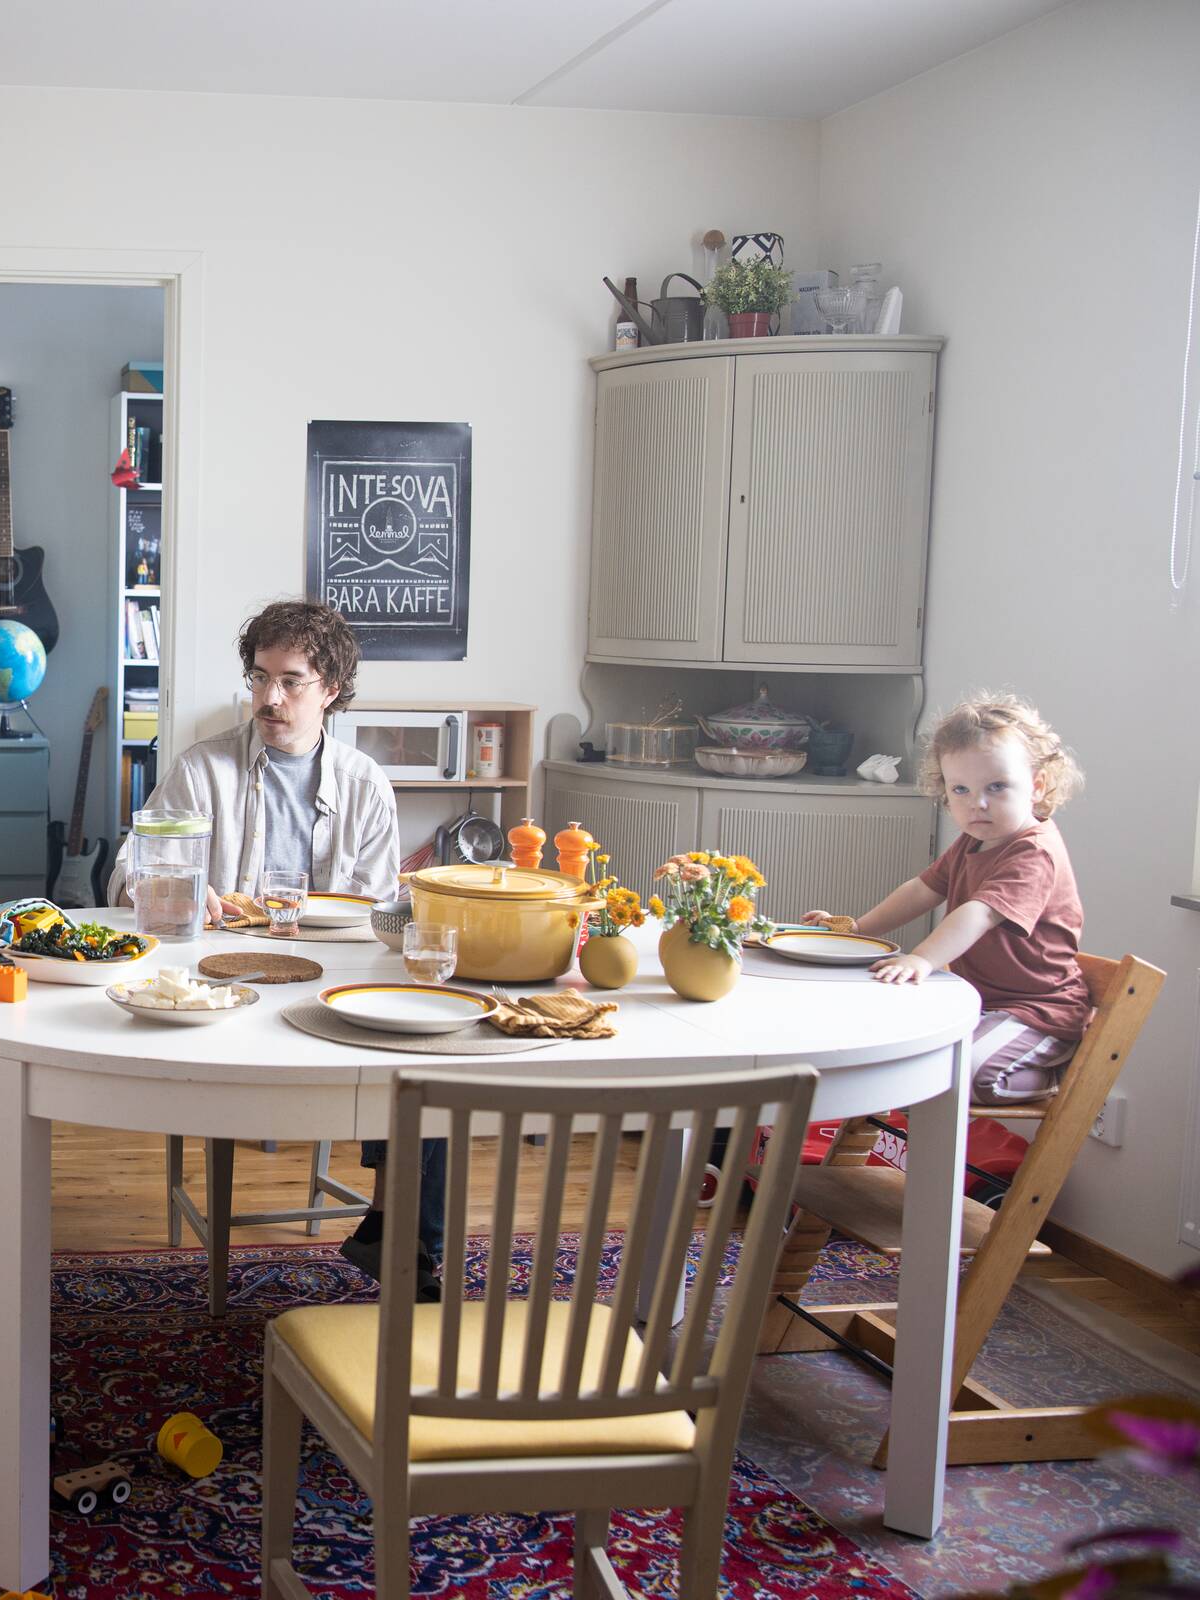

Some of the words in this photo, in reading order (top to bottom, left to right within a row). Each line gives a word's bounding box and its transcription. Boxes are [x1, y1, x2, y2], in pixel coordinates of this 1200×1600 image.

[329, 474, 387, 517] INTE
[391, 474, 452, 518] SOVA
[326, 586, 381, 613] BARA
[386, 586, 450, 613] KAFFE
